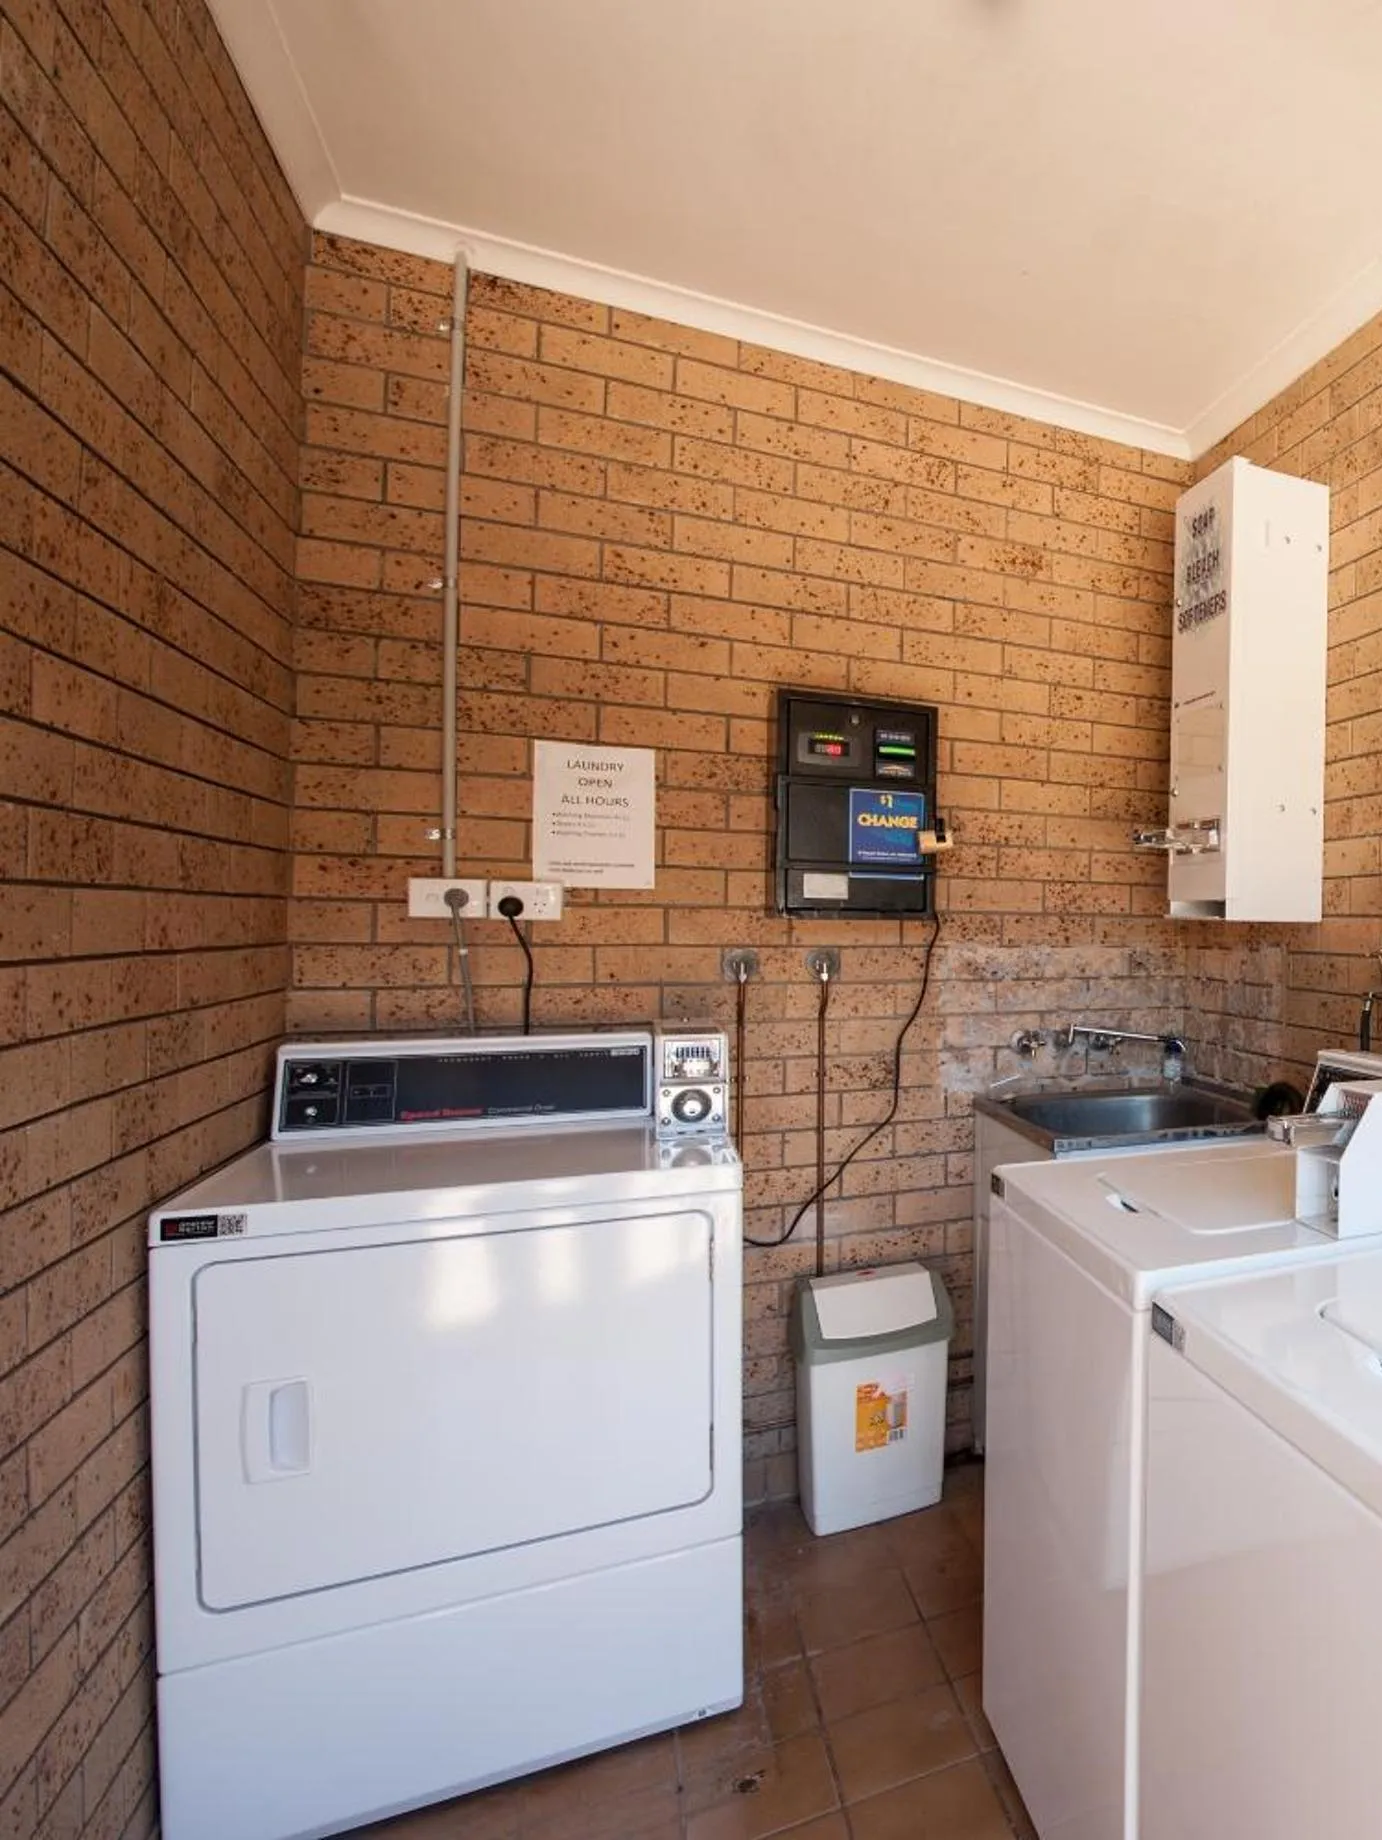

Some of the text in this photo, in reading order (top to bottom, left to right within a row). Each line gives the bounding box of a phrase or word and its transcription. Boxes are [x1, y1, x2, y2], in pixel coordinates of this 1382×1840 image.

[1192, 507, 1215, 538] SOAP
[1186, 549, 1219, 585] BLEACH
[567, 759, 624, 772] LAUNDRY
[578, 777, 613, 789] OPEN
[561, 795, 629, 807] ALL HOURS
[857, 813, 918, 828] CHANGE
